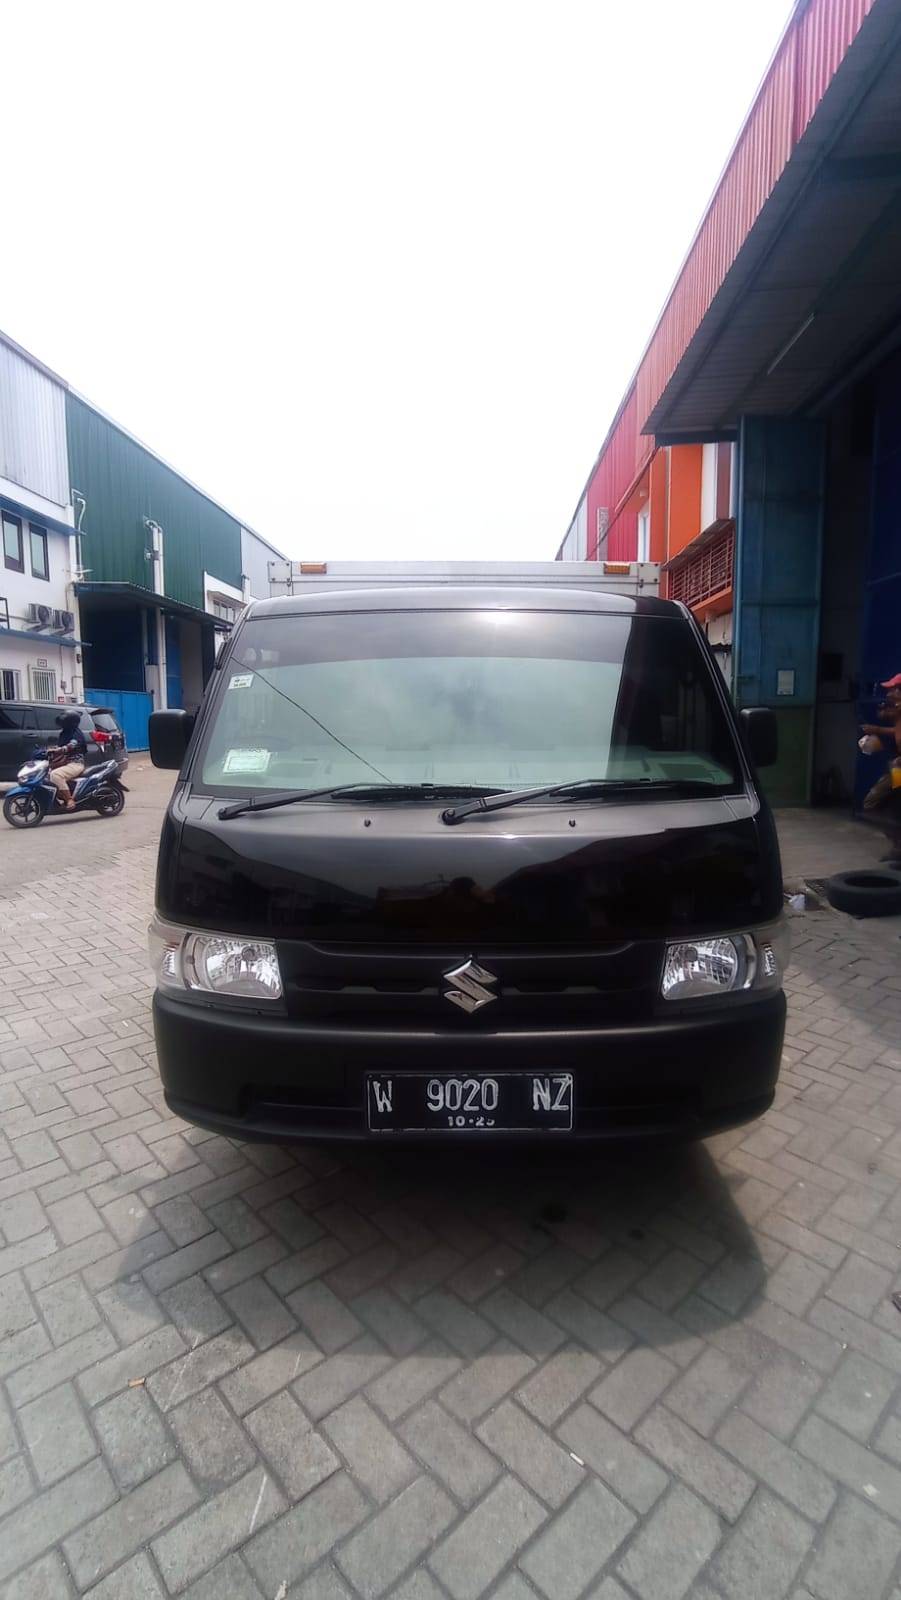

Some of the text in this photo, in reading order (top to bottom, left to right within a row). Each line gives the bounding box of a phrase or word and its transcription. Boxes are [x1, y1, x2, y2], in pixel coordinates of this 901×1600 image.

[373, 1078, 571, 1112] W 9020 NZ
